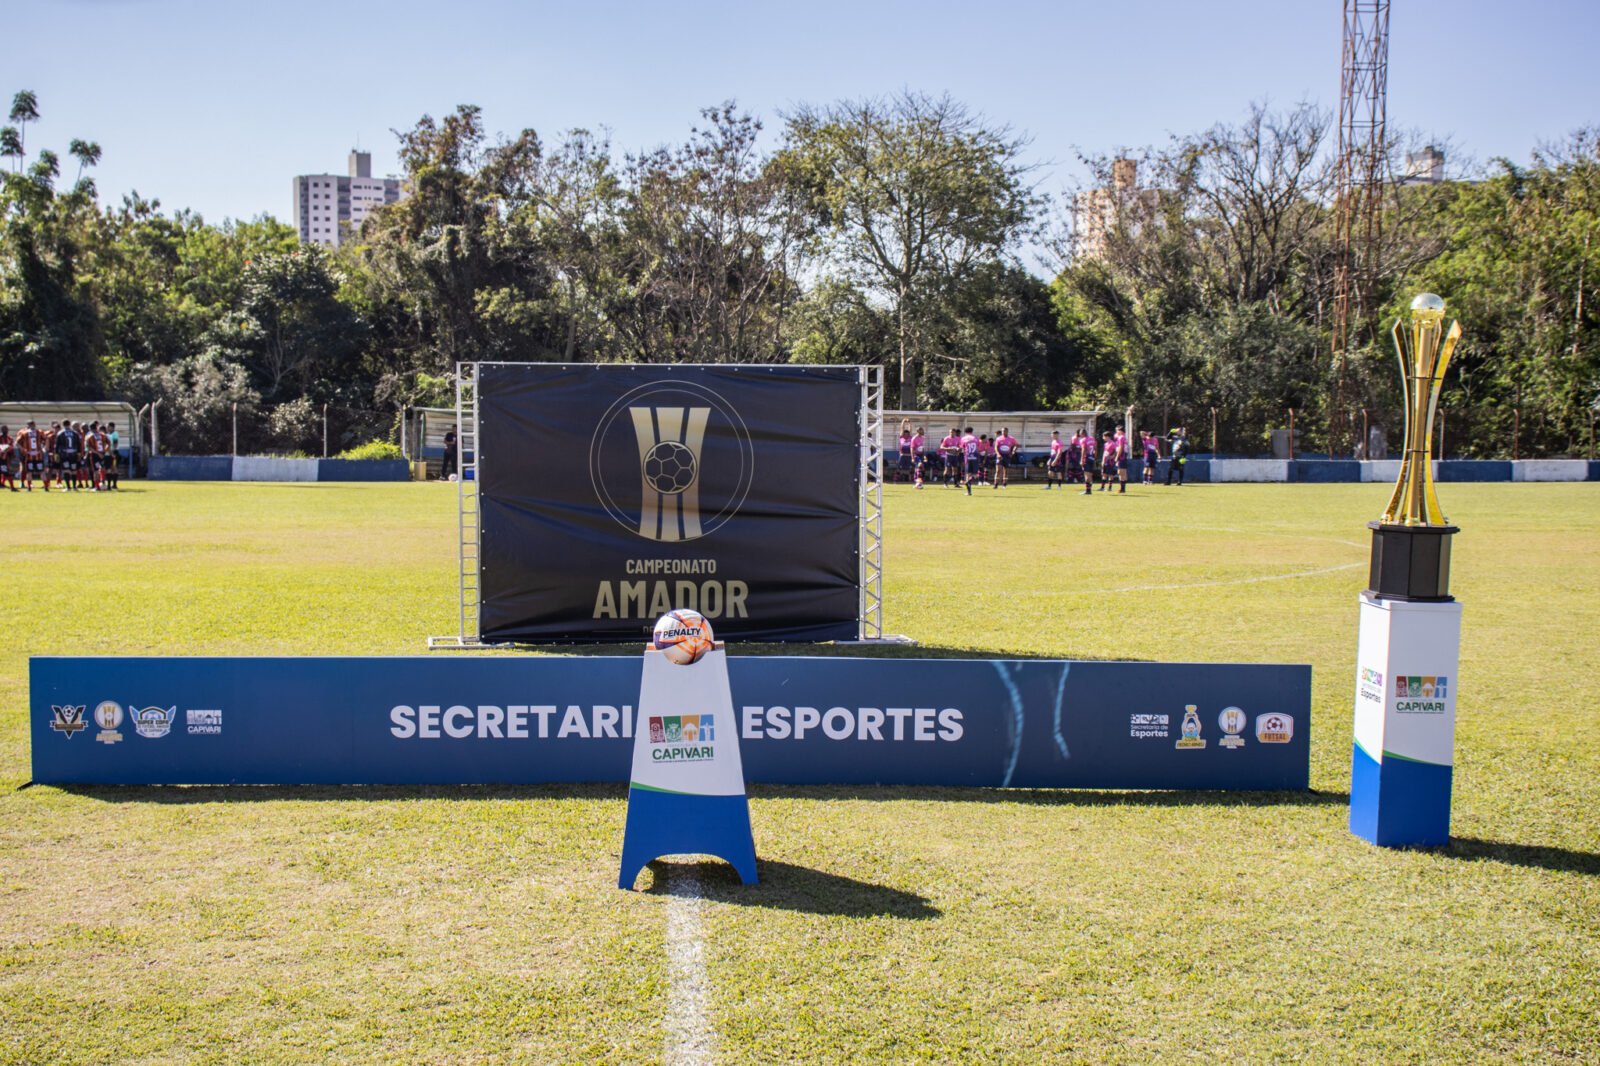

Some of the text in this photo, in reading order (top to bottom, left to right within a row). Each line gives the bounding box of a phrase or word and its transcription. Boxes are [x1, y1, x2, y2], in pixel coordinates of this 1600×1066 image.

[967, 442, 977, 454] 19
[626, 559, 717, 574] CAMPEONATO
[592, 580, 749, 618] AMADOR
[663, 628, 701, 638] PENALTY
[1396, 701, 1445, 712] CAPIVARI
[389, 705, 964, 742] SECRETARI ESPORTES
[187, 725, 222, 735] CAPIVARI
[1130, 729, 1169, 739] Esportes
[1264, 732, 1286, 741] FUTSAL
[652, 746, 714, 761] CAPIVARI
